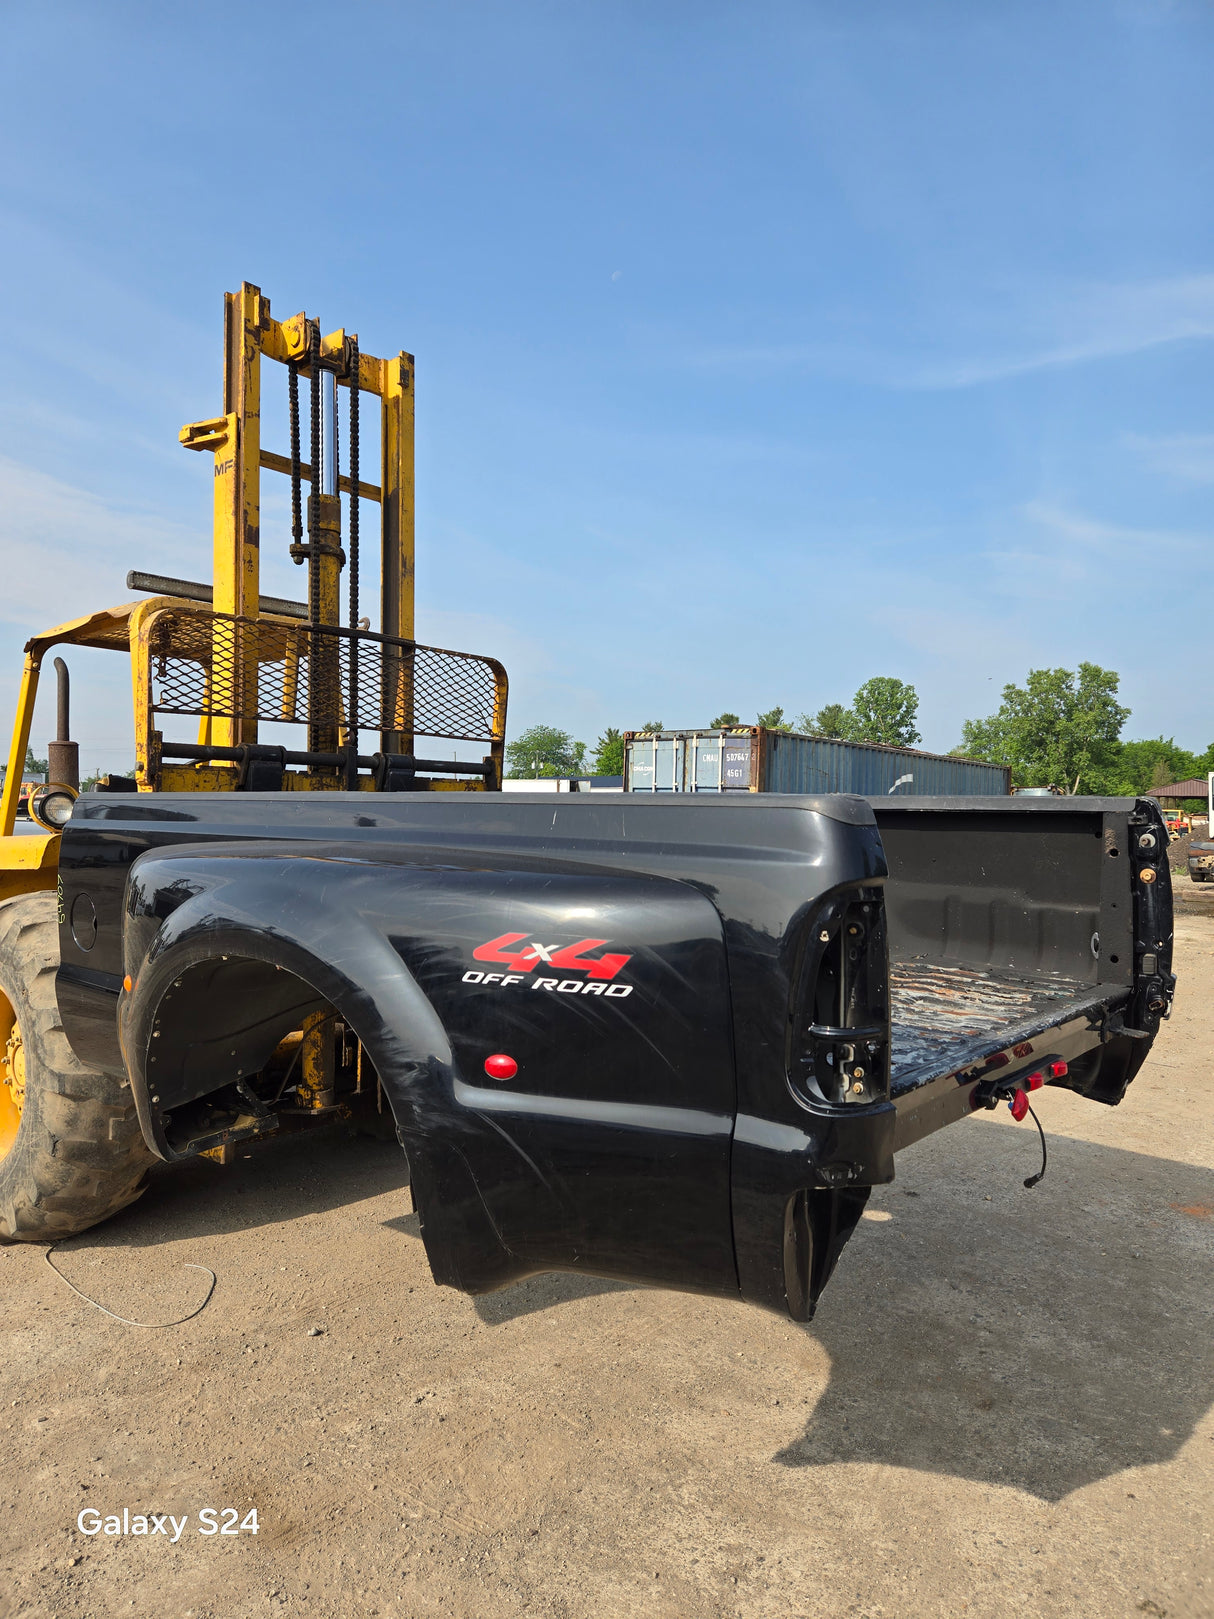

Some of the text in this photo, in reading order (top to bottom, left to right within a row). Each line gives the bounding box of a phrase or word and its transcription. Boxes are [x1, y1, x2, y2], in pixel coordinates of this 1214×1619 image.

[214, 459, 233, 477] MF
[702, 753, 718, 762] CMAU
[726, 753, 749, 762] 507647
[726, 769, 742, 778] 45G1
[461, 970, 634, 998] OFF ROAD
